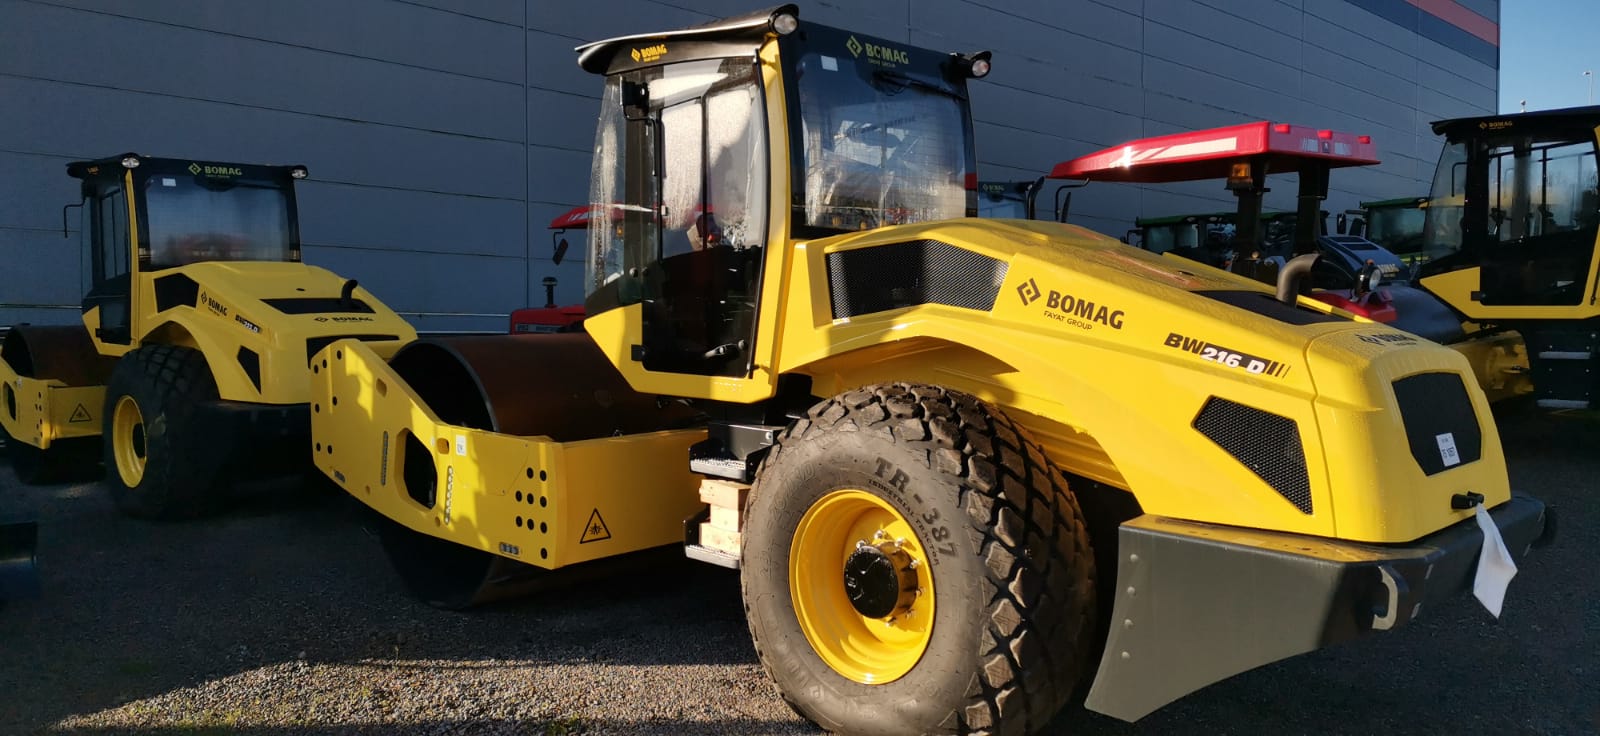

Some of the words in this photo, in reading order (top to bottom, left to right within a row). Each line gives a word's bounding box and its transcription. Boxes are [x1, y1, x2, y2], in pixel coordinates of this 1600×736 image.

[640, 44, 667, 58] BOMAG
[204, 166, 242, 176] BOMAG
[209, 297, 227, 316] BOMAG
[1046, 290, 1125, 329] BOMAG
[1043, 311, 1065, 321] FAYAT
[1067, 318, 1092, 330] GROUP
[1246, 359, 1266, 374] D
[915, 519, 939, 565] TRACTOR
